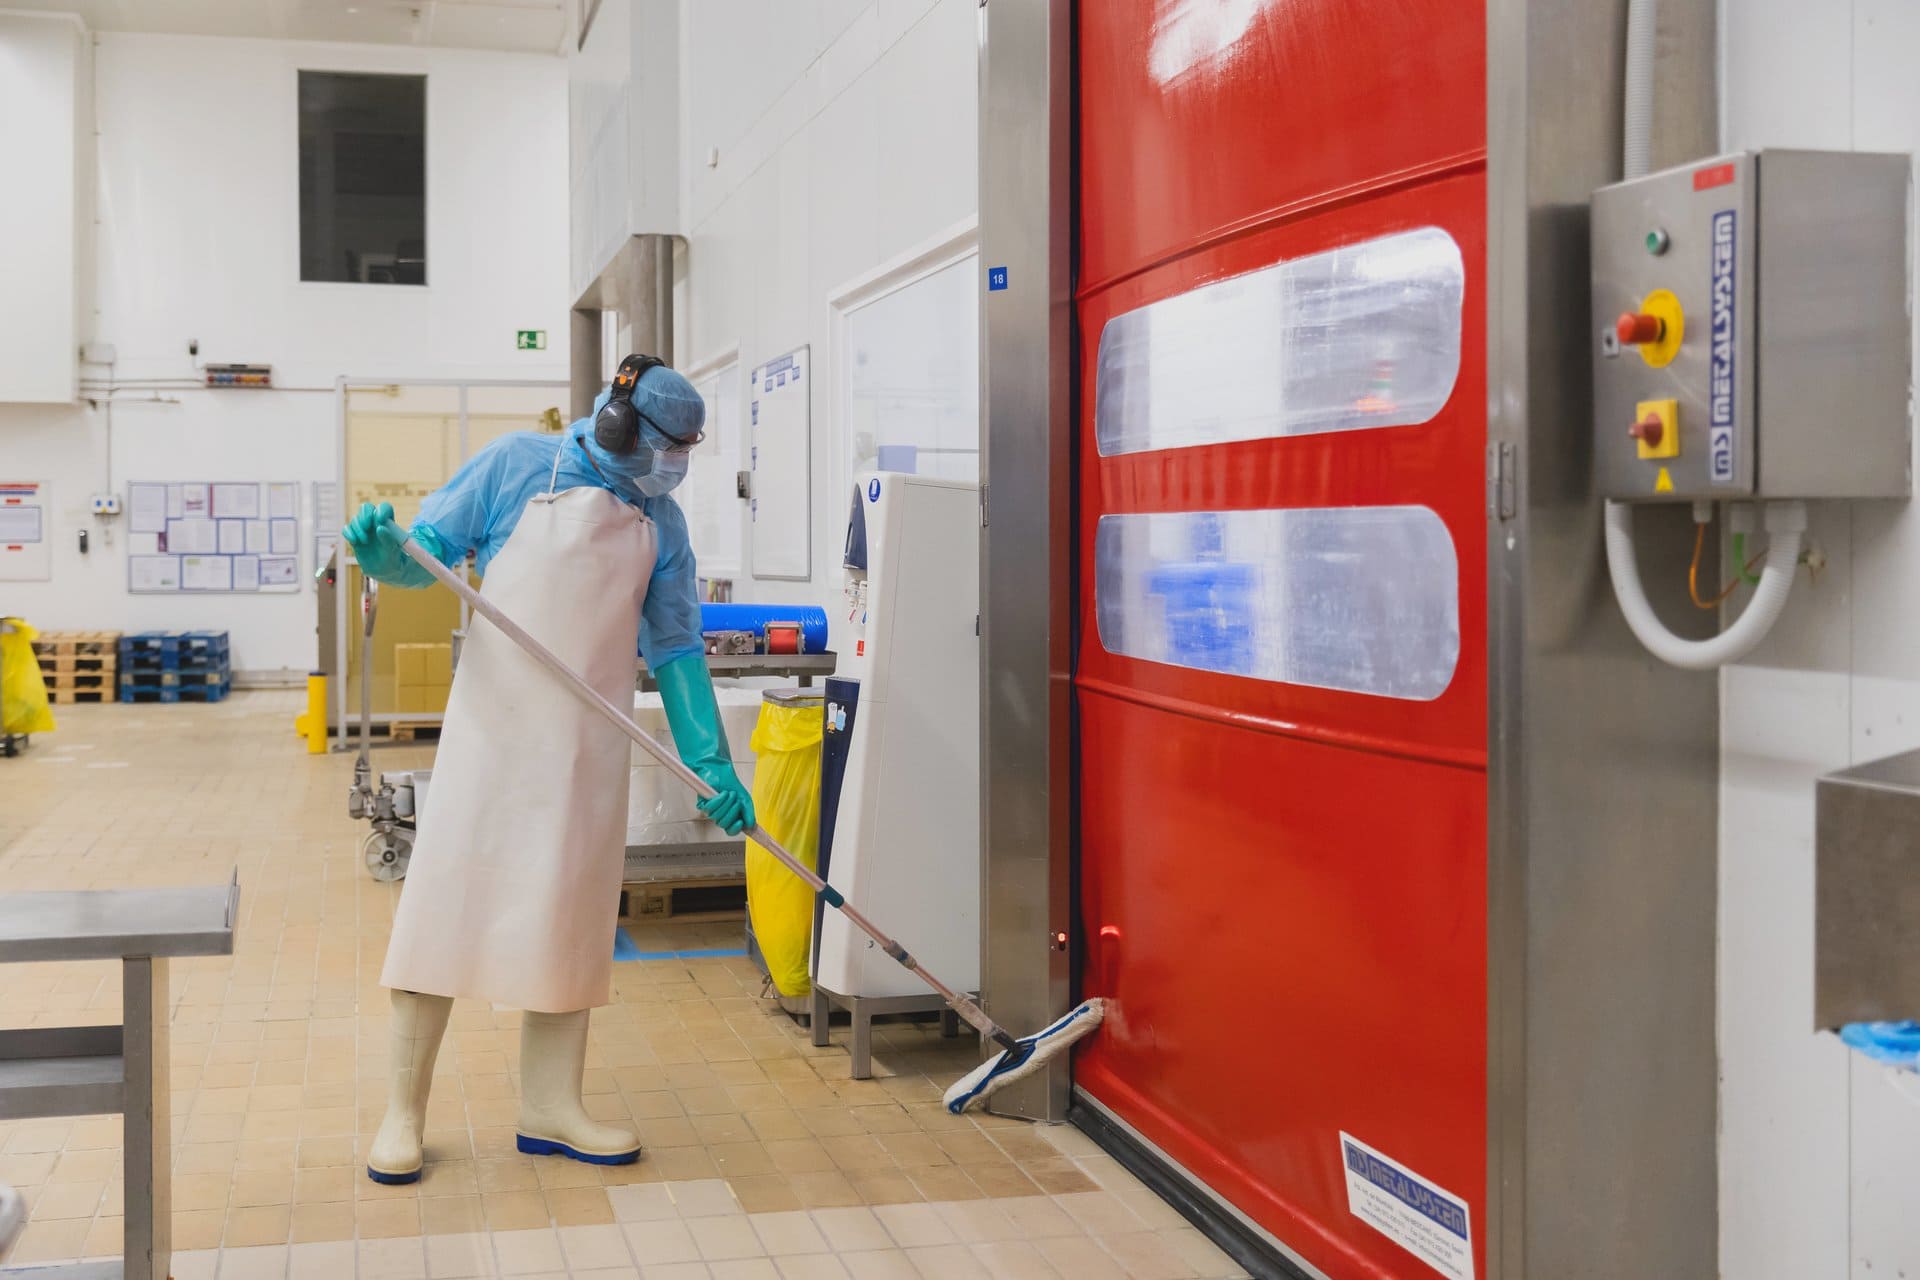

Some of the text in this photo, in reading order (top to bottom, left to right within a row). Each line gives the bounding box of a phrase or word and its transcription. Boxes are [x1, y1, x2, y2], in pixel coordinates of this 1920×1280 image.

[993, 274, 1004, 285] 18
[1713, 213, 1733, 424] METALSYSTEM
[1369, 1158, 1466, 1235] METALSYSTEM
